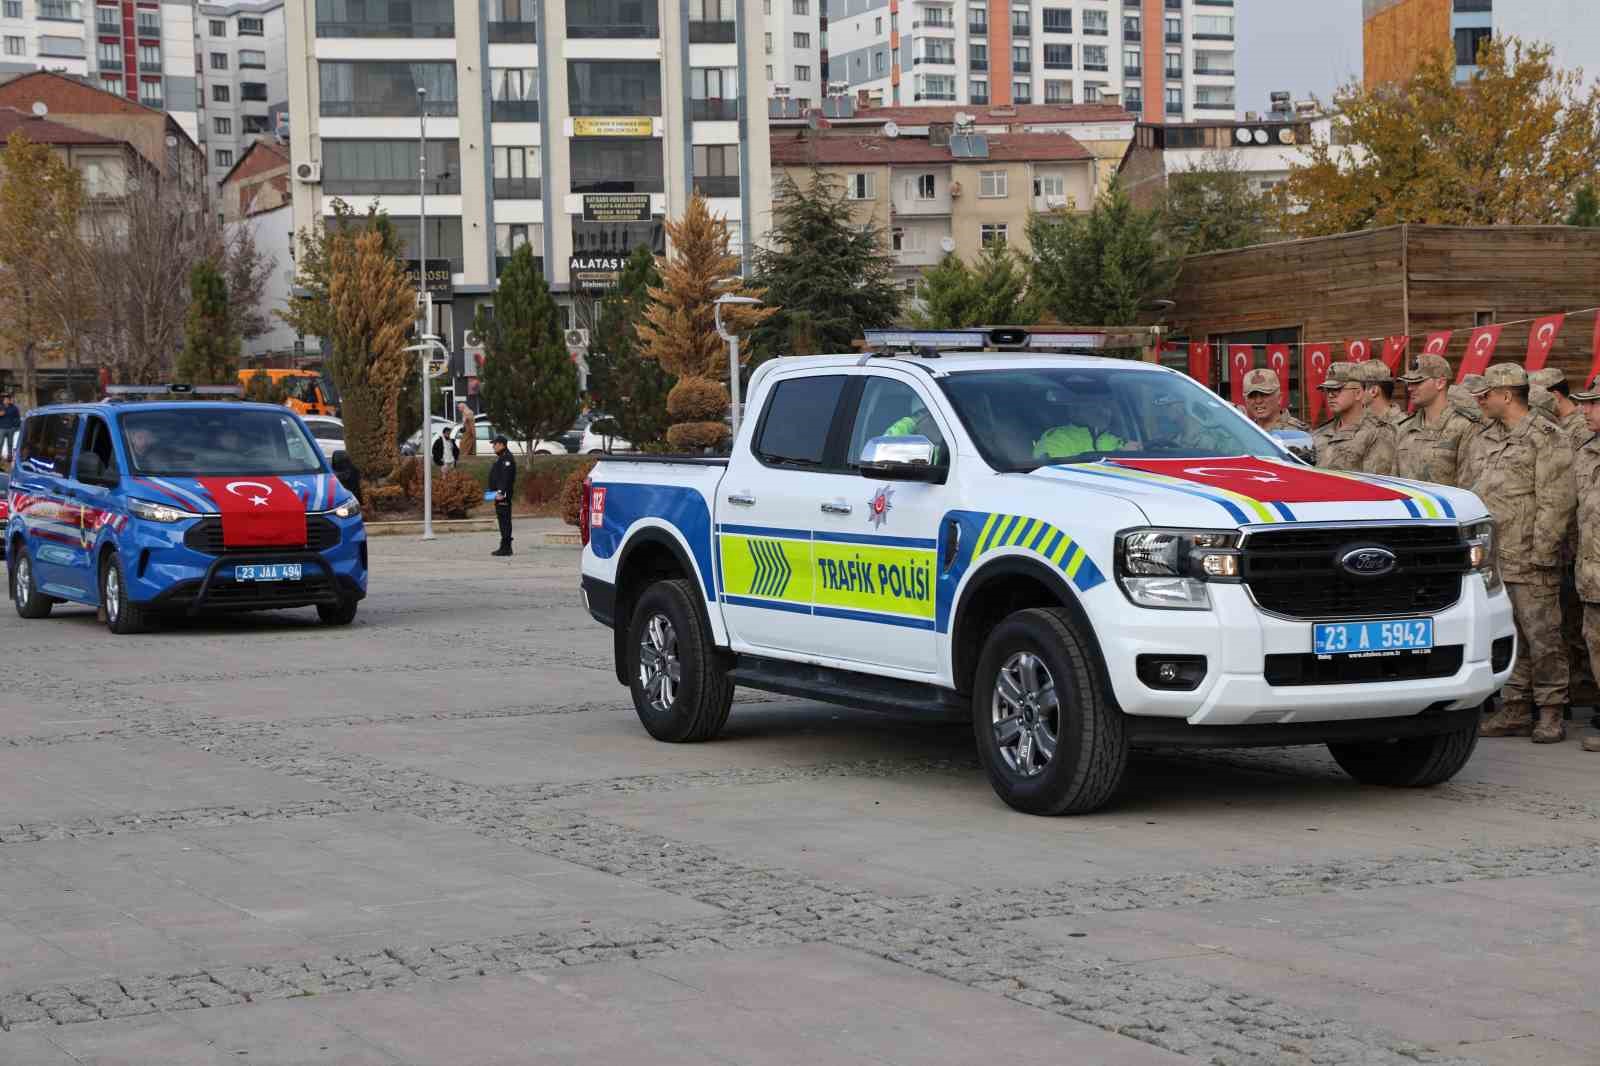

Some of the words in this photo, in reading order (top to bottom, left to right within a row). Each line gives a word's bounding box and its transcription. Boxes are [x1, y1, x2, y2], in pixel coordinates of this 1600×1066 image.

[570, 258, 618, 270] ALATAŞ
[1357, 553, 1386, 569] Ford
[242, 567, 255, 578] 23
[282, 566, 300, 577] 494
[818, 553, 875, 594] TRAFİK
[877, 558, 930, 601] POLİSİ
[1325, 626, 1347, 650] 23
[1359, 624, 1370, 649] A
[1382, 622, 1426, 647] 5942
